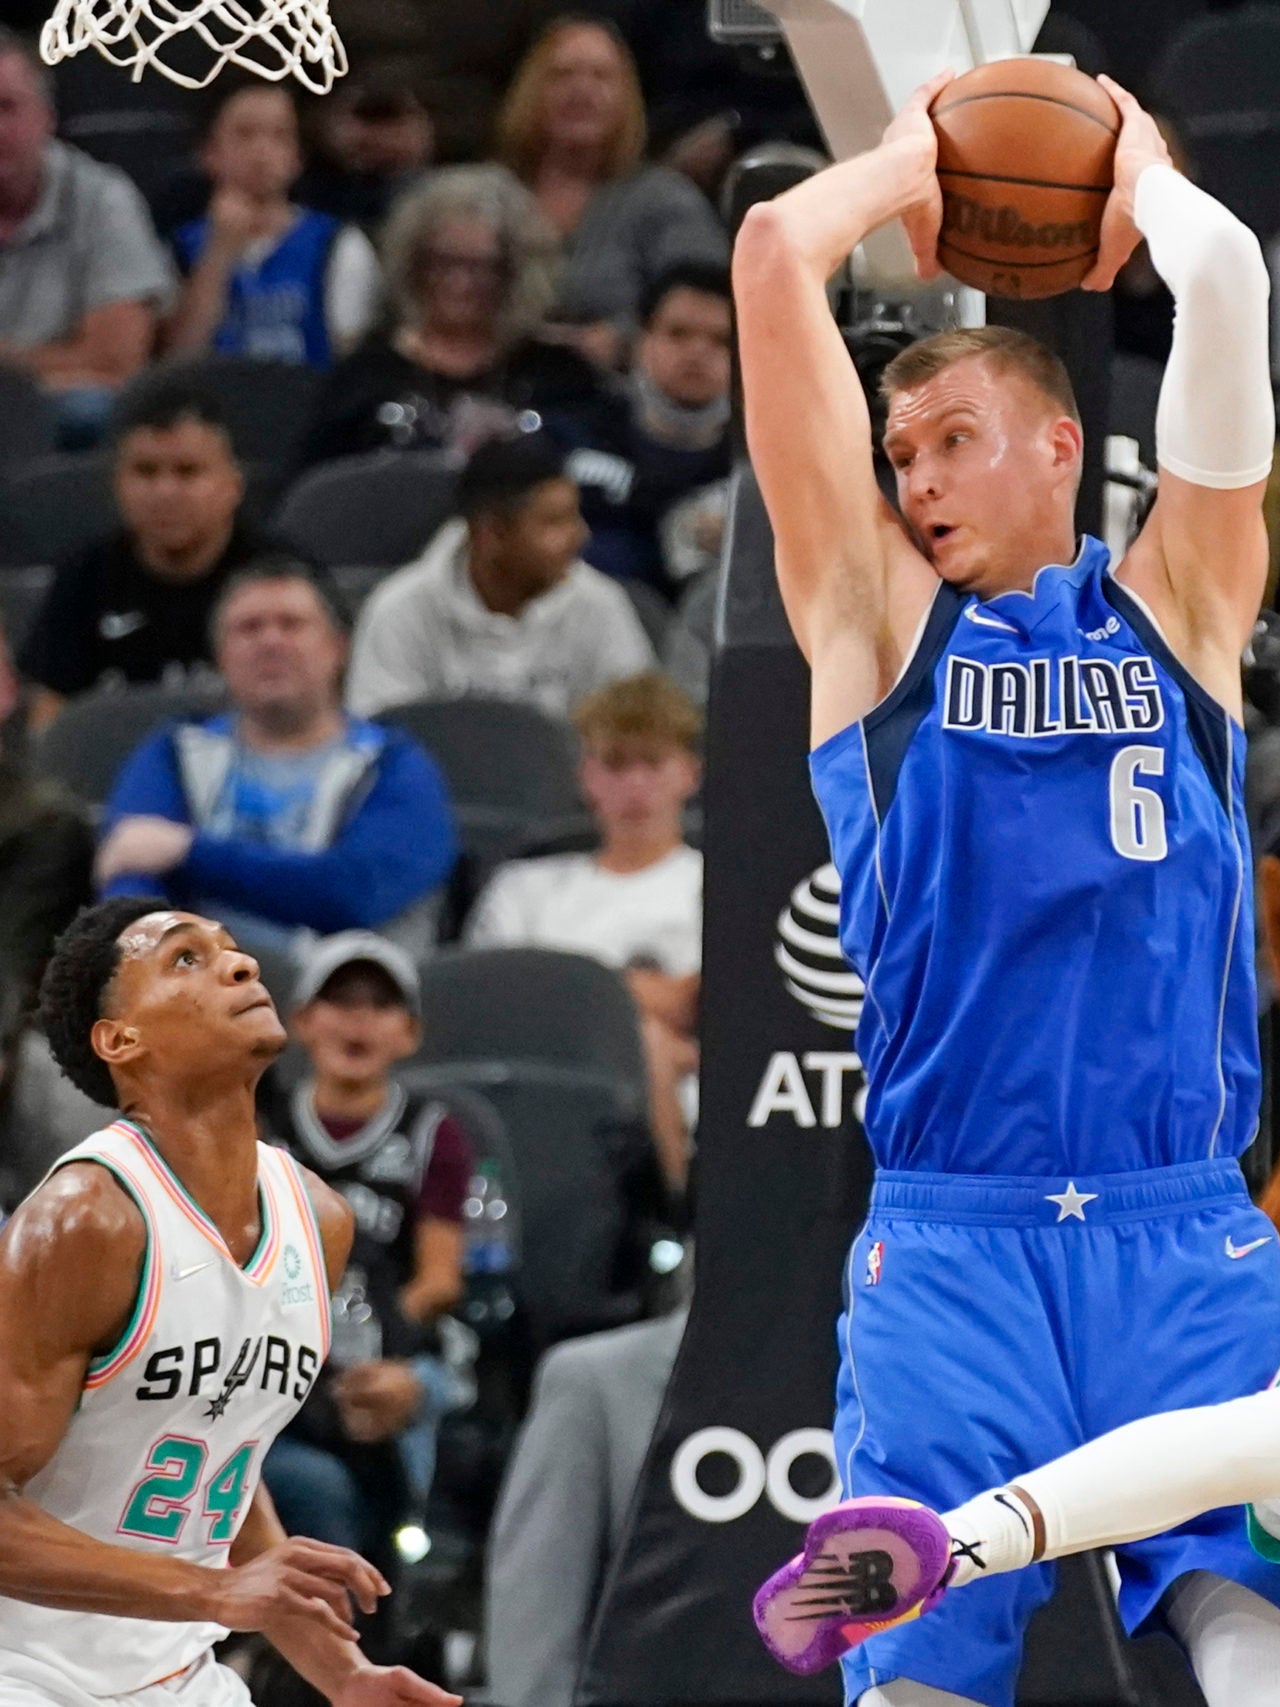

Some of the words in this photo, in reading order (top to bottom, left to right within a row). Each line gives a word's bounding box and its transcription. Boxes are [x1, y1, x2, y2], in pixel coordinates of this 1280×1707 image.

[942, 654, 1165, 737] DALLAS
[1109, 744, 1168, 861] 6
[746, 1051, 869, 1128] AT
[136, 1334, 318, 1422] SPURS
[116, 1433, 261, 1545] 24
